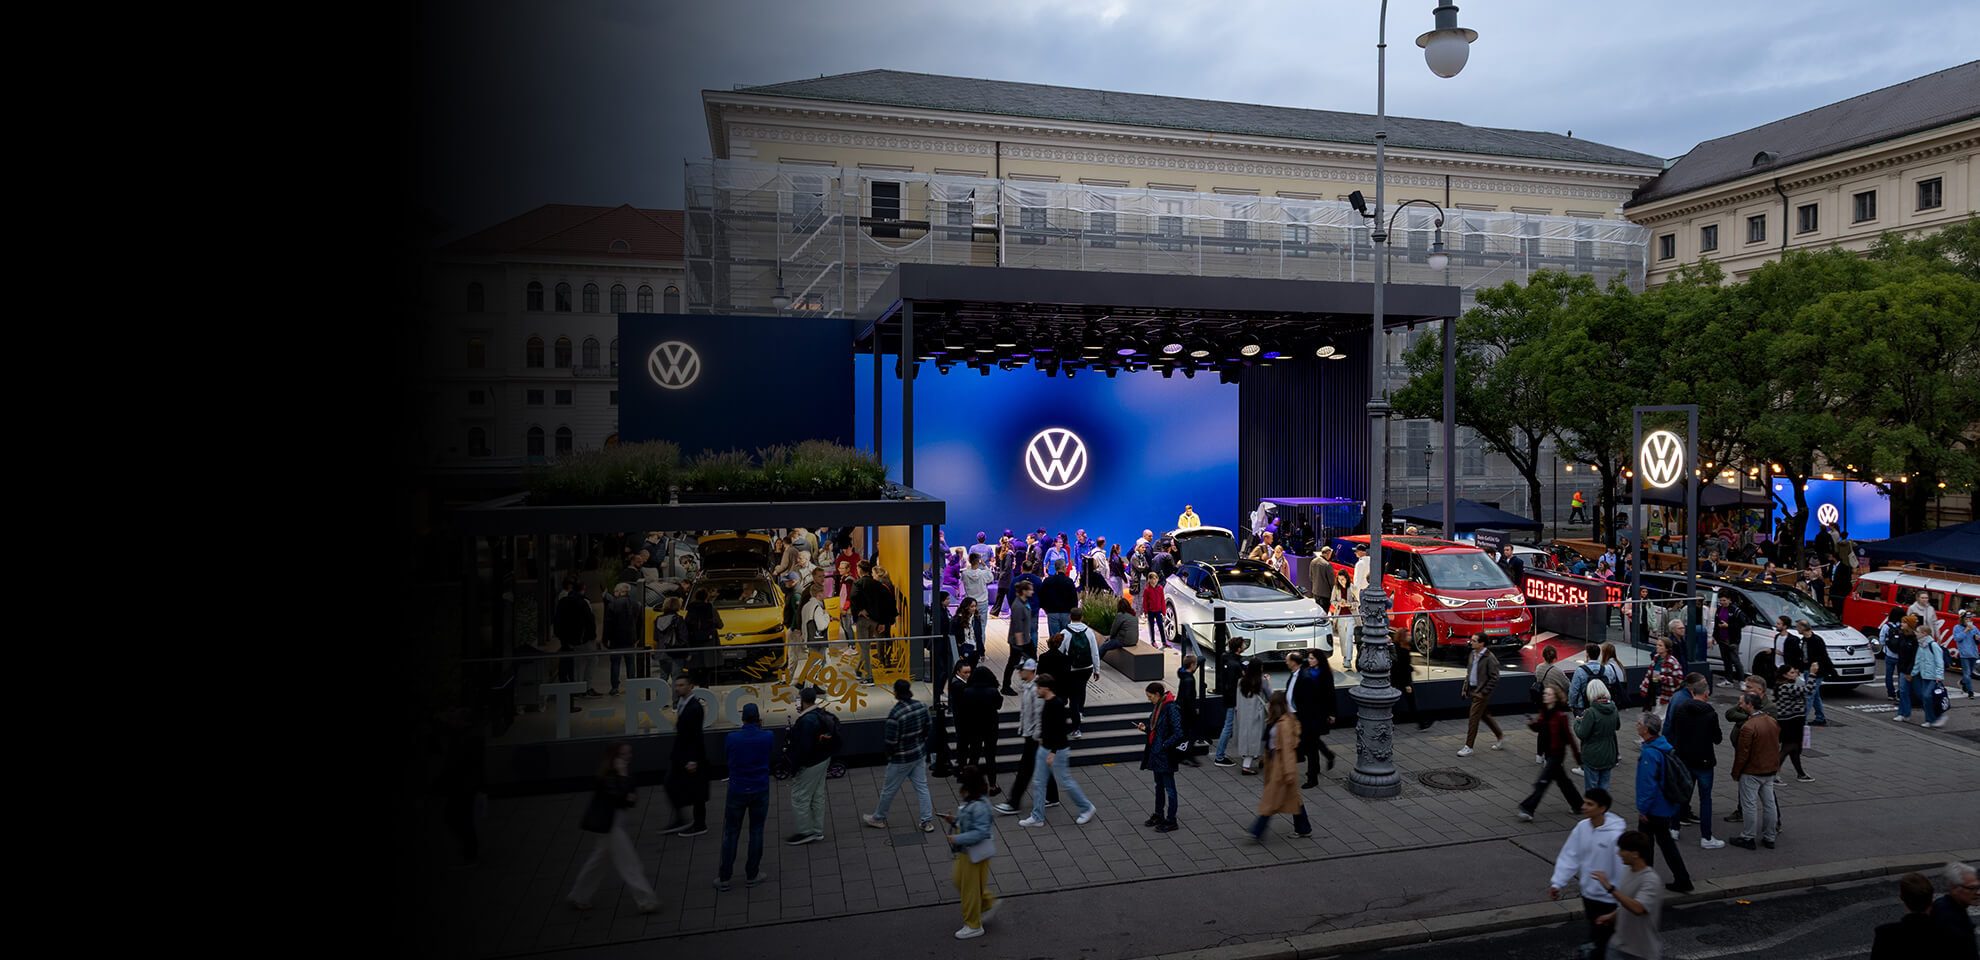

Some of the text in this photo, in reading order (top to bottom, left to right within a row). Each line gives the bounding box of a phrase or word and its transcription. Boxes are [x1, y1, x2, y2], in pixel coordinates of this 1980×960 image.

[648, 341, 700, 389] VW
[1025, 428, 1087, 490] VW
[1641, 431, 1683, 488] VW
